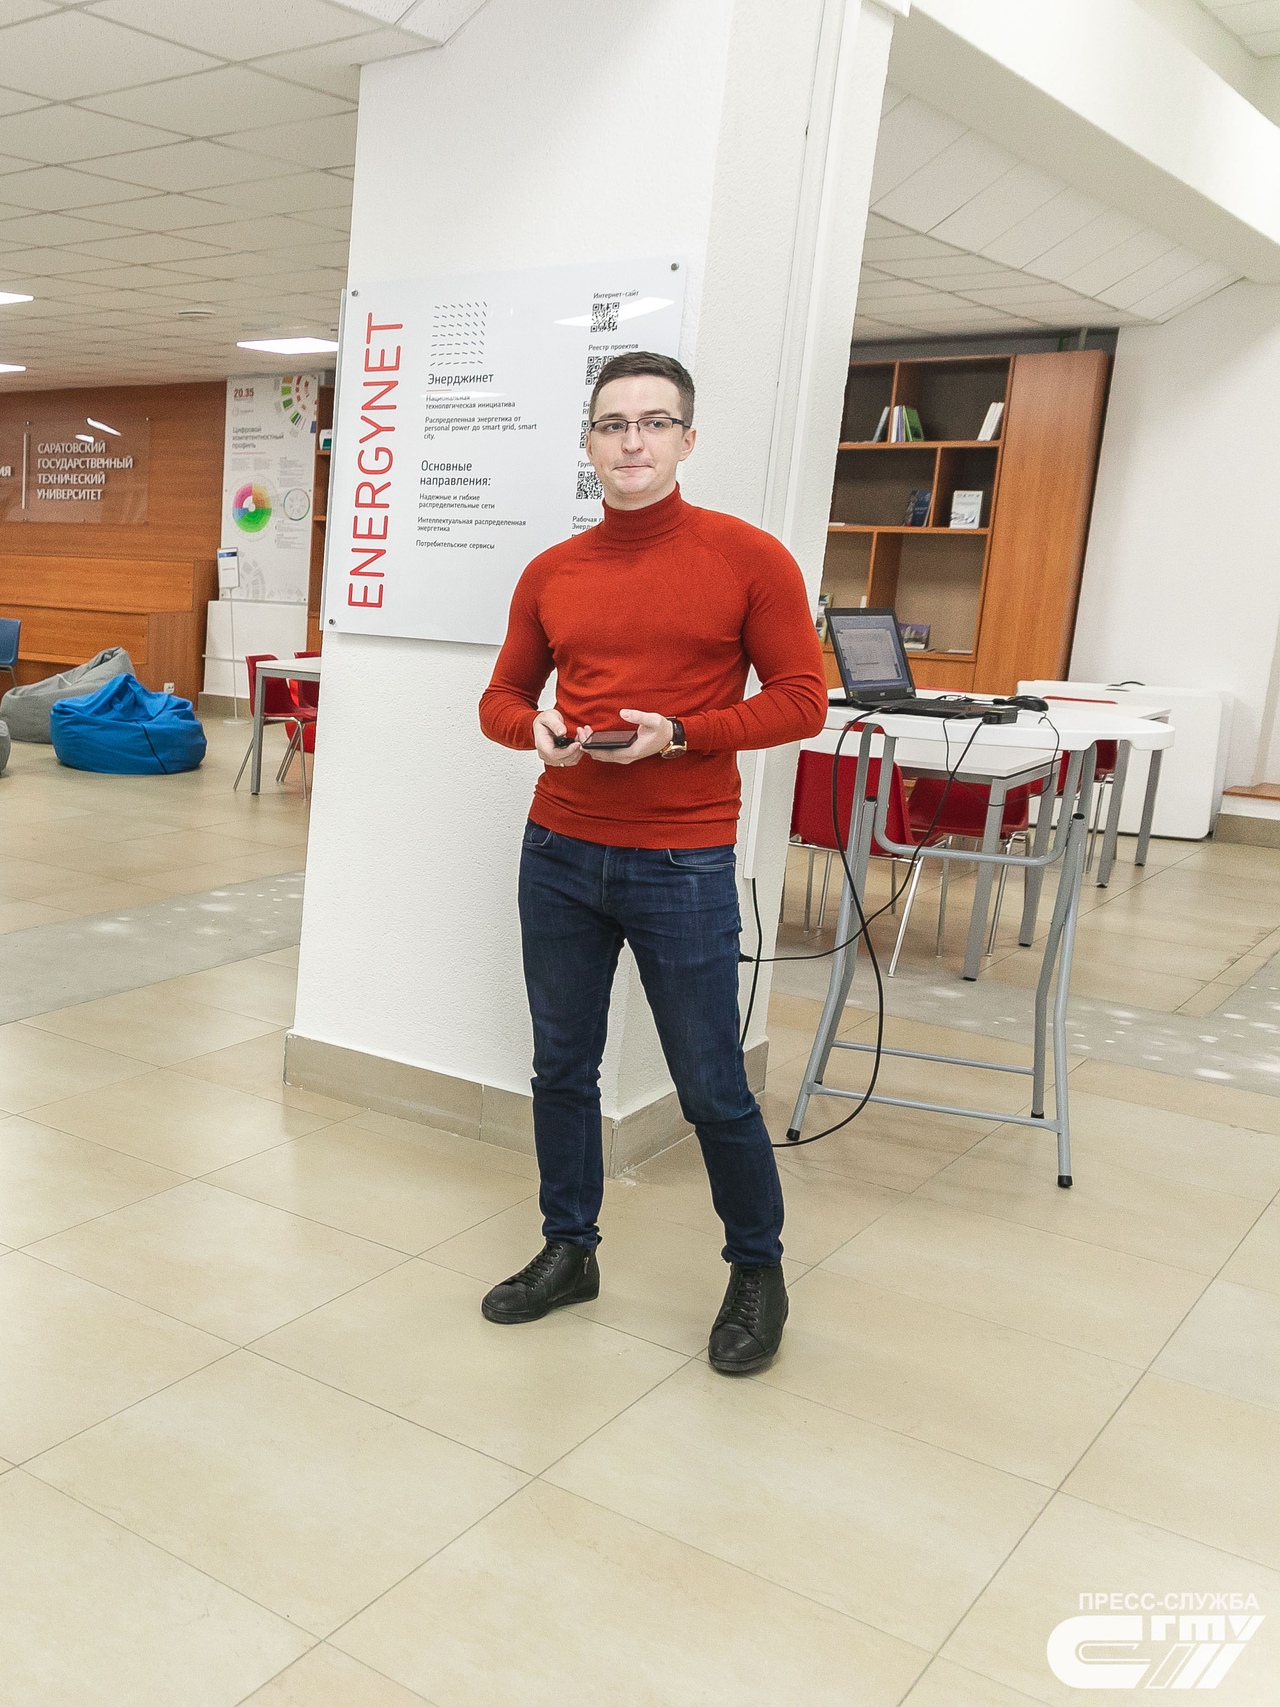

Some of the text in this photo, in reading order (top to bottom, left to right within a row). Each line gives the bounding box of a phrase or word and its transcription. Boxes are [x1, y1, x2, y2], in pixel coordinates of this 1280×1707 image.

[593, 290, 639, 299] Интернет-сайт
[588, 343, 639, 352] Реестр проектов
[427, 373, 494, 386] Энерджинет
[425, 401, 516, 410] технологическая инициатива
[425, 416, 475, 424] Распределенная
[424, 424, 450, 433] personal
[451, 424, 470, 432] power
[501, 423, 516, 432] grid,
[423, 433, 436, 441] city.
[37, 441, 106, 454] САРАТОВСКИЙ
[37, 455, 133, 470] ГОСУДАРСТВЕННЫЙ
[347, 312, 404, 609] ENERGYNET
[421, 460, 473, 472] Основные
[37, 471, 106, 485] ТЕХНИЧЕСКИЙ
[419, 477, 491, 488] направления:
[37, 488, 103, 501] УНИВЕРСИТЕТ
[419, 493, 452, 501] Надежные
[458, 493, 480, 501] гибкие
[418, 502, 480, 510] распределительные
[417, 517, 473, 525] Интеллектуальная
[415, 539, 468, 549] Потребительские
